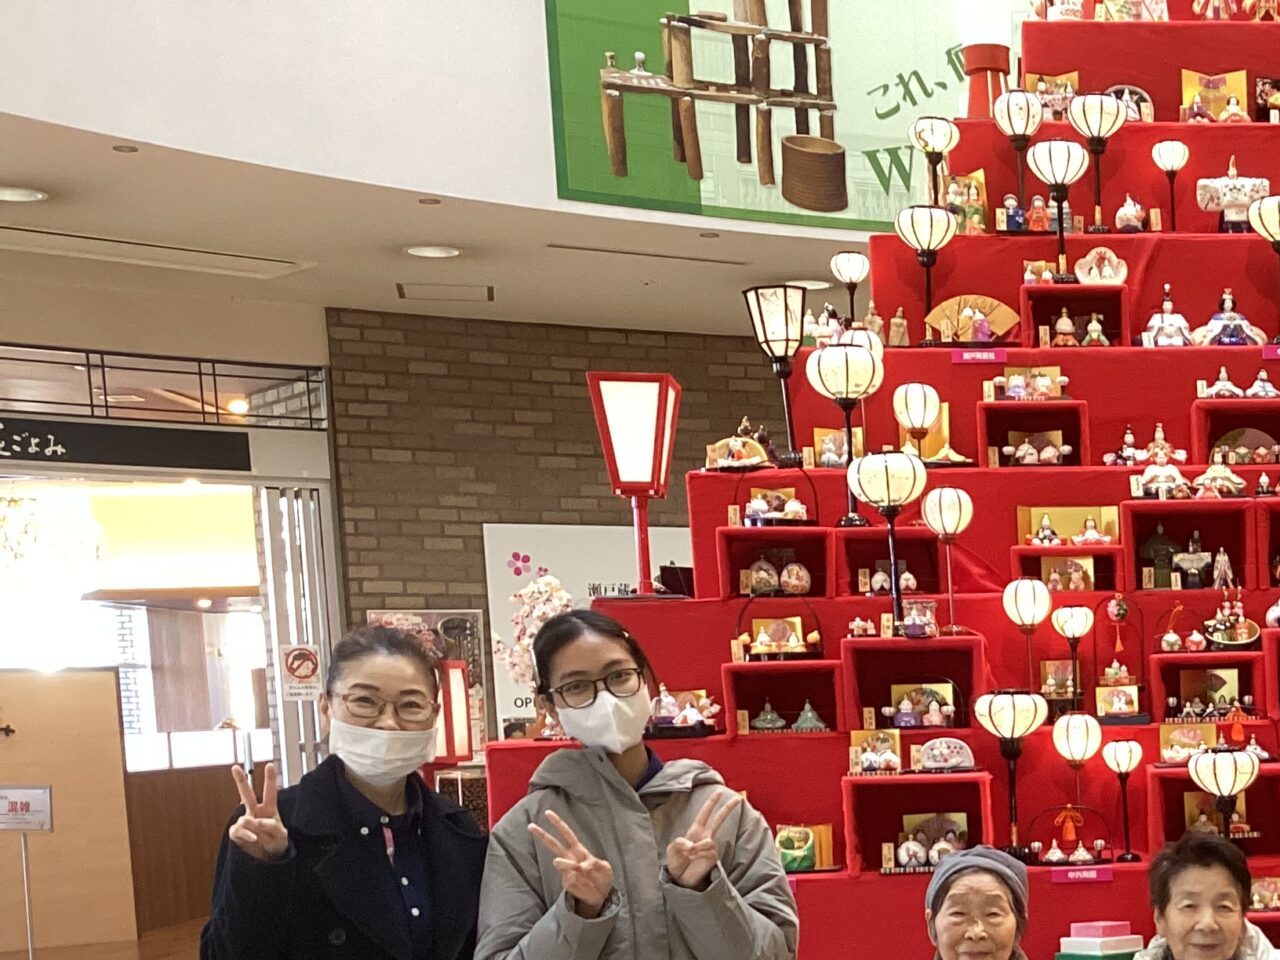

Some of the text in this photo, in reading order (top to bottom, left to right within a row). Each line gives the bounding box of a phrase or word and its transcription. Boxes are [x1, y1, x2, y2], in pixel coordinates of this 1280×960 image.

[0, 422, 66, 457] ごよみ
[514, 697, 536, 709] OP
